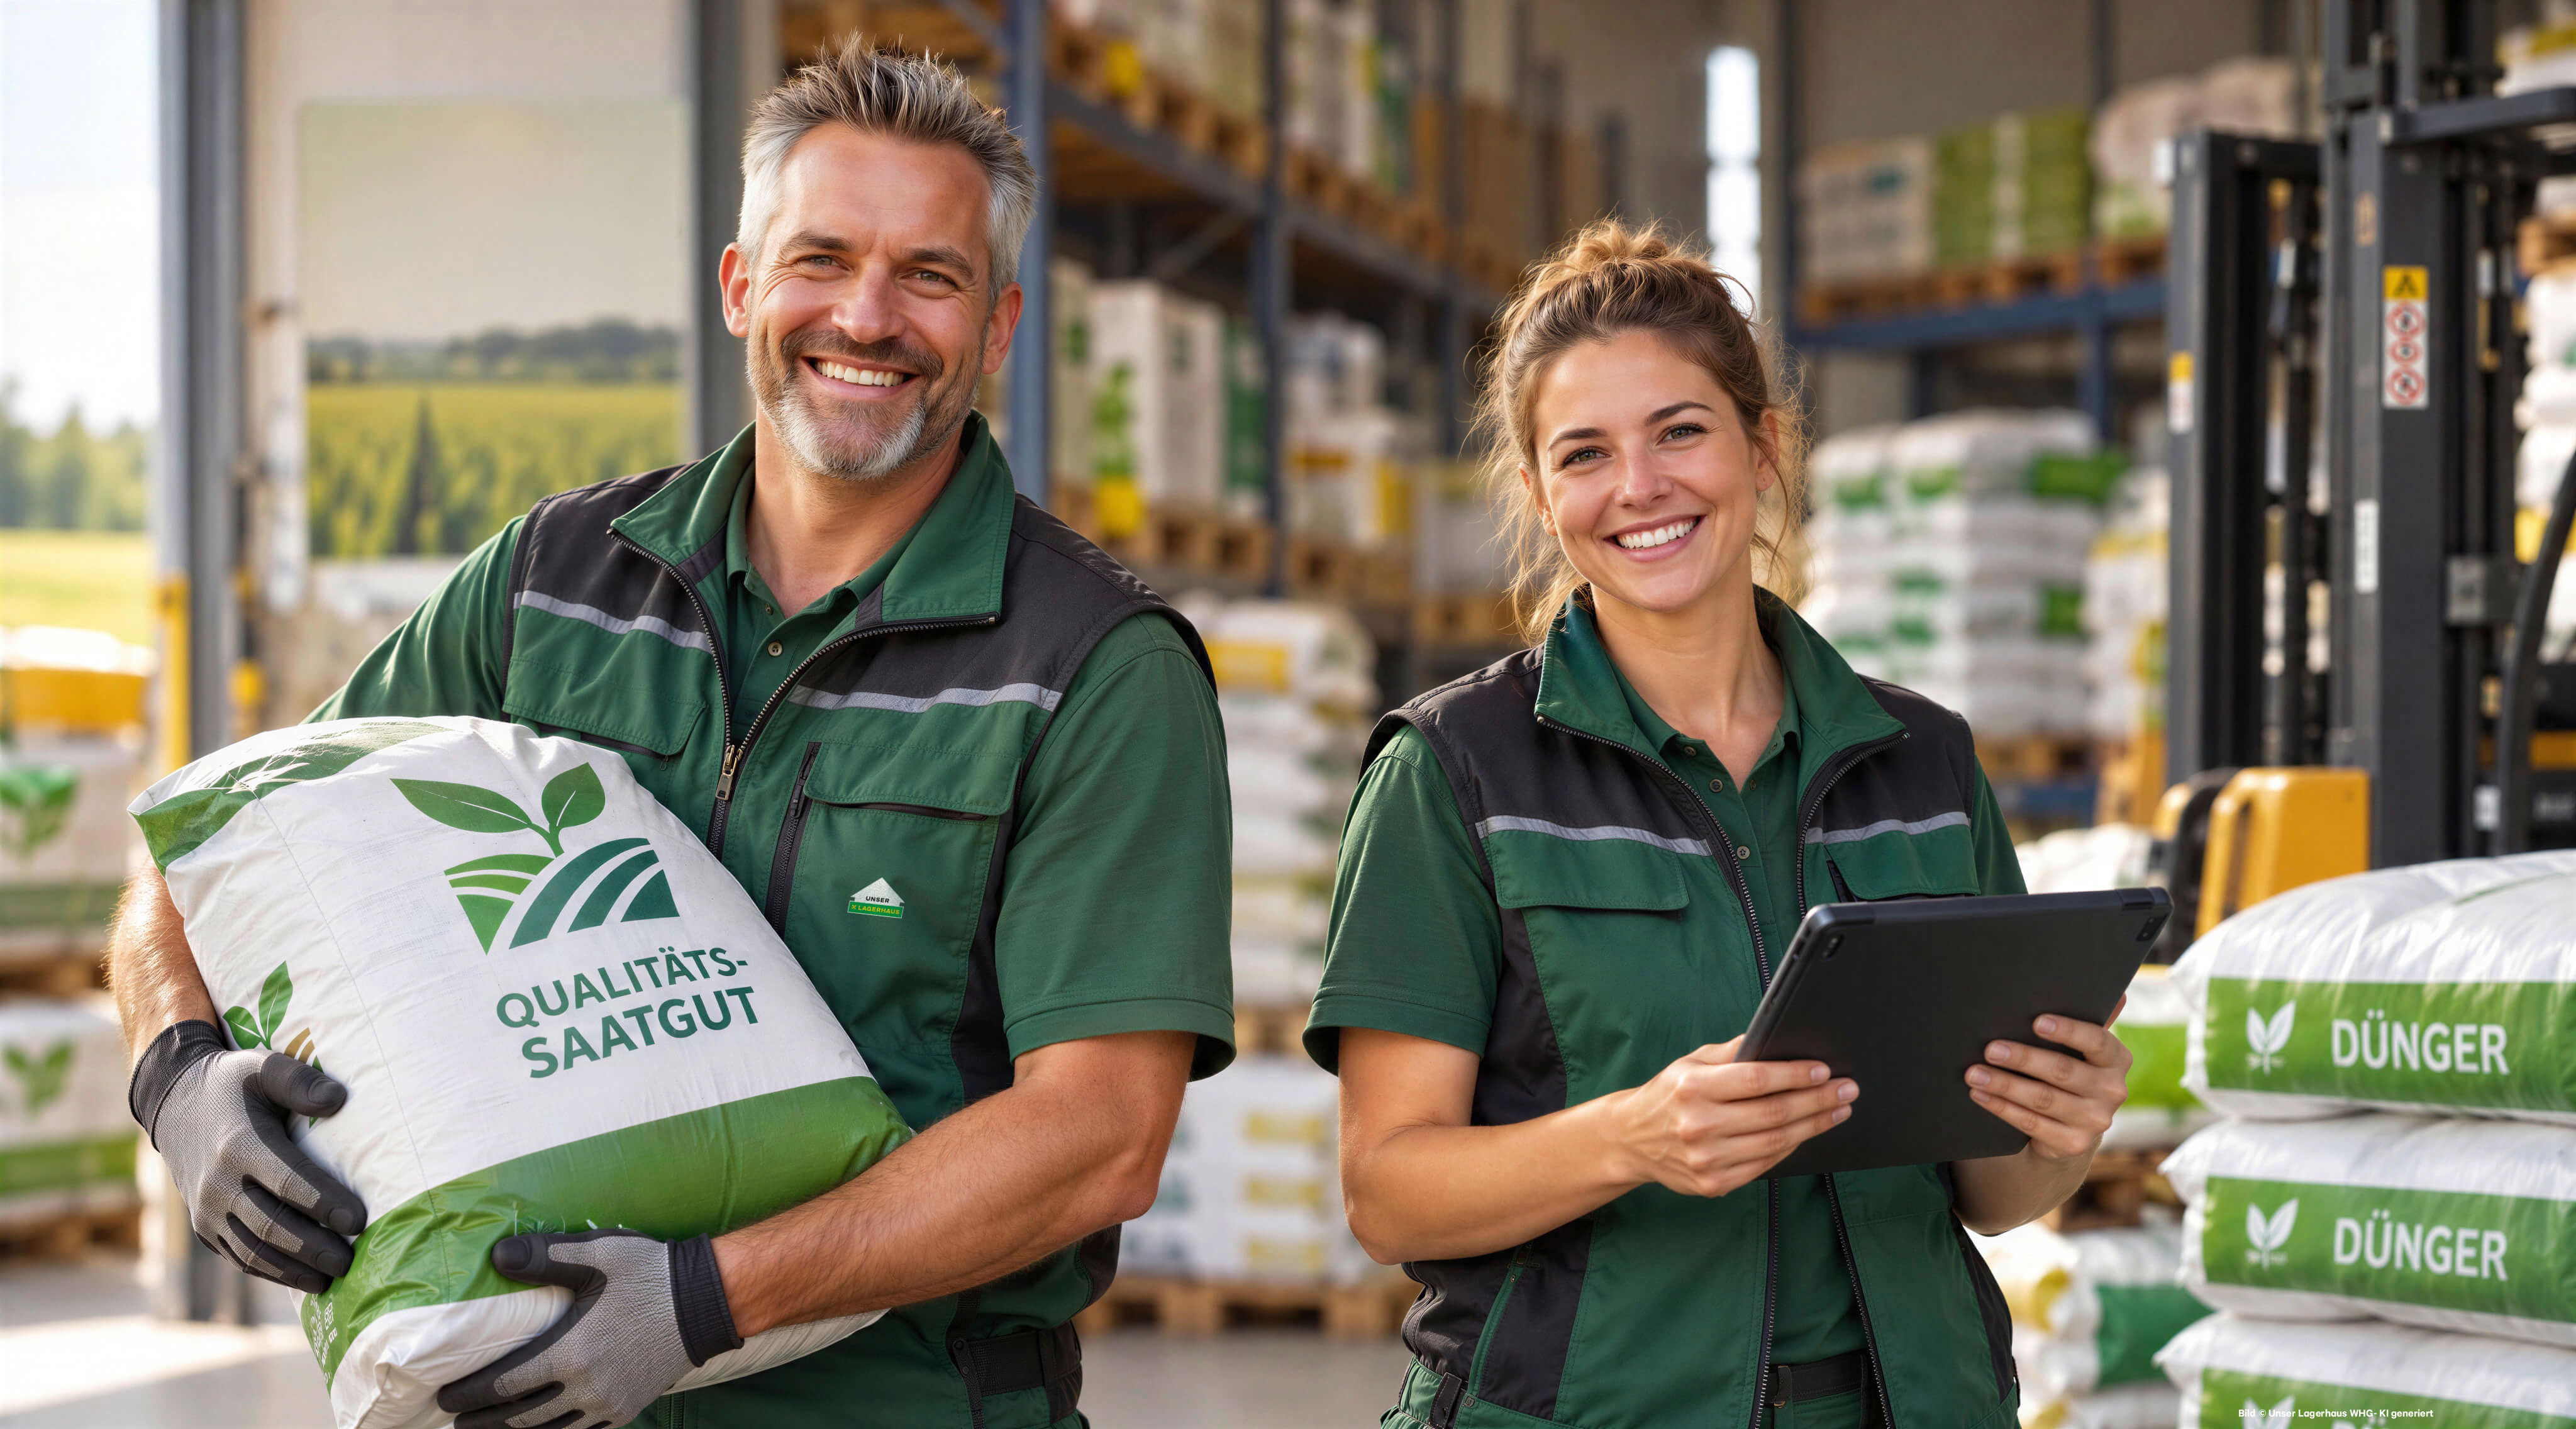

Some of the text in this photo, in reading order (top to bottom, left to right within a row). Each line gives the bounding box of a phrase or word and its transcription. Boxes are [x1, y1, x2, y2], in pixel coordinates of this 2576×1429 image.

[858, 905, 900, 915] LAGERHAUS
[496, 946, 749, 1028] QUALITÄTS-
[521, 986, 759, 1078] SAATGUT
[2331, 1009, 2510, 1075] DÜNGER
[2334, 1209, 2508, 1281] DÜNGER
